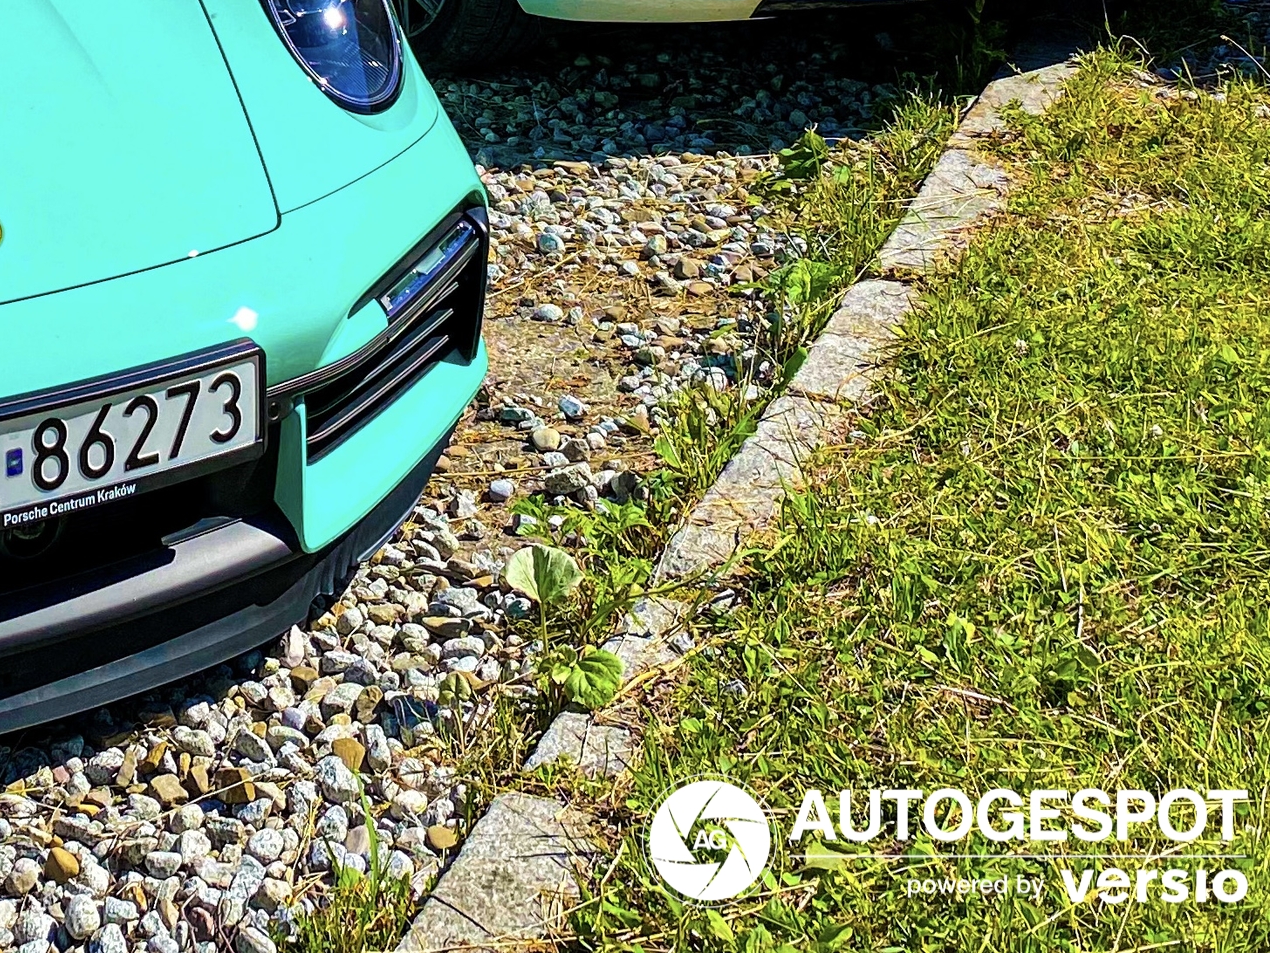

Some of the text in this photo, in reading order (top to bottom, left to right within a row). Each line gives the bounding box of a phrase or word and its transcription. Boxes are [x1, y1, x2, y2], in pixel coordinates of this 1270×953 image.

[32, 372, 243, 492] 86273
[3, 482, 137, 526] Porsche Centrum Kraków
